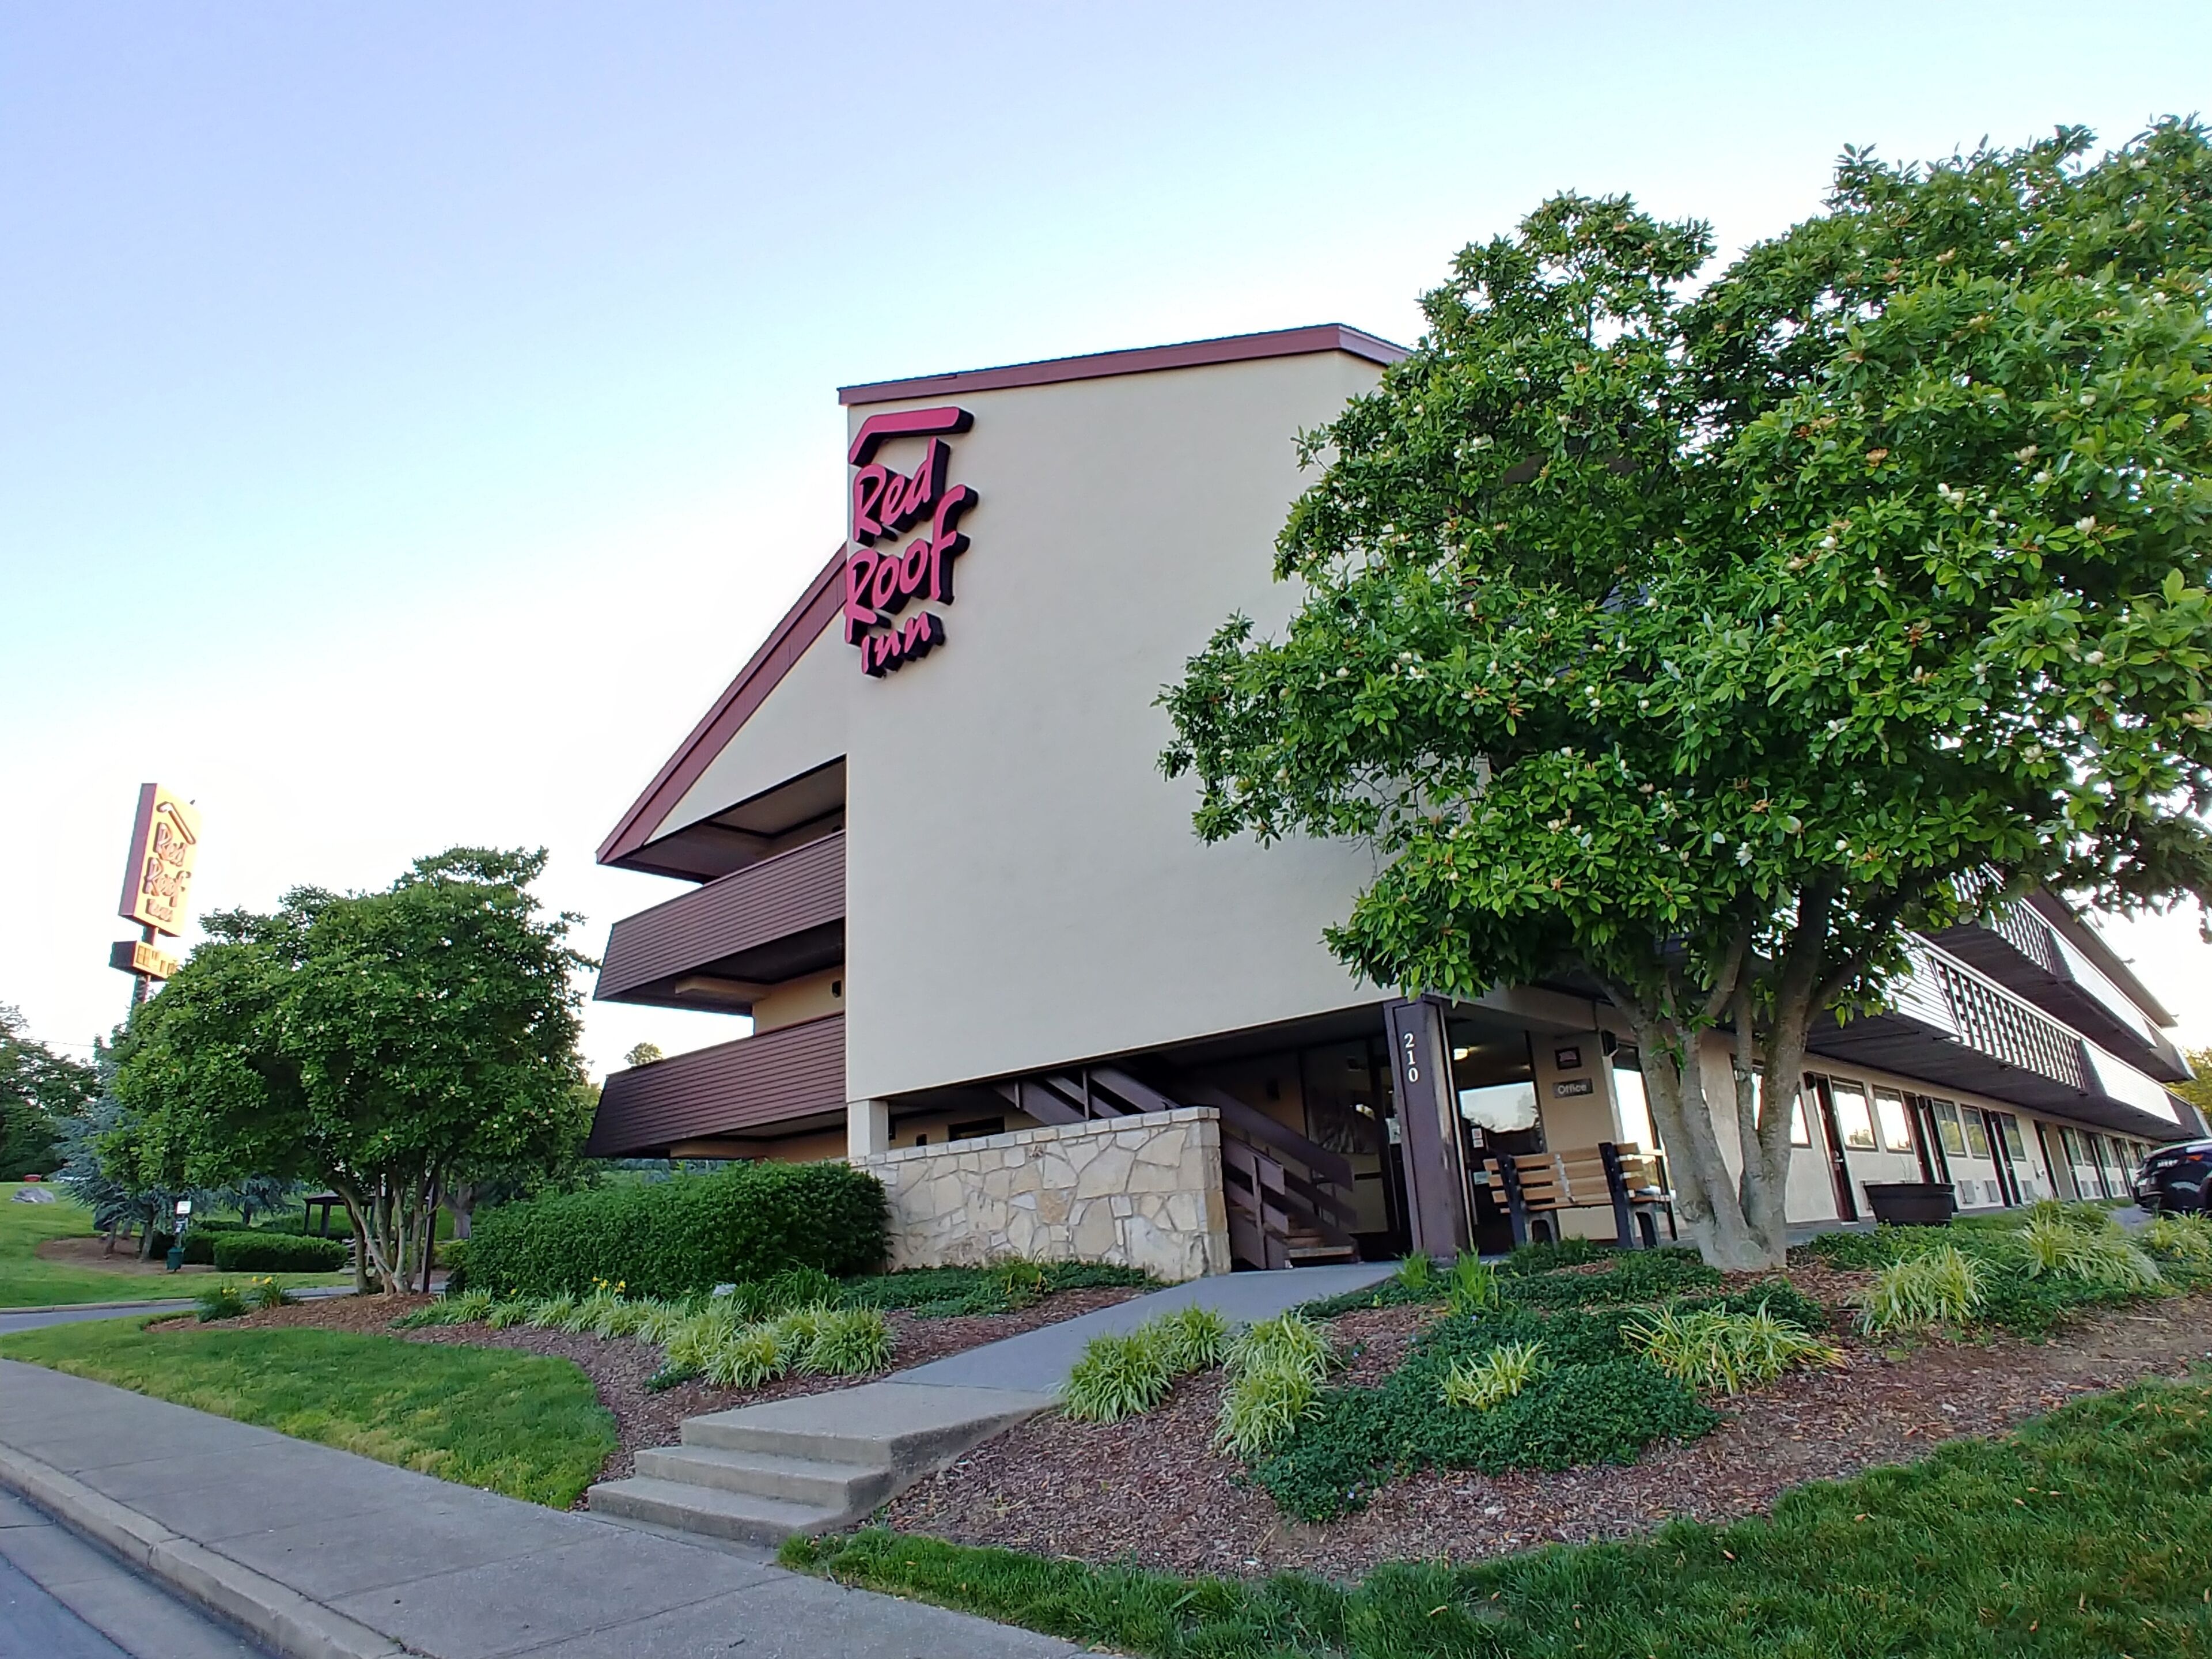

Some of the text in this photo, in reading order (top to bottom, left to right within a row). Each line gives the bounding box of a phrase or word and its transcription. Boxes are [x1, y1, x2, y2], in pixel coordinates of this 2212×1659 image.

[853, 437, 945, 544] Red
[844, 484, 971, 644] Roof
[861, 612, 939, 676] Inn
[1404, 1033, 1418, 1082] 210
[1558, 1084, 1587, 1094] Office
